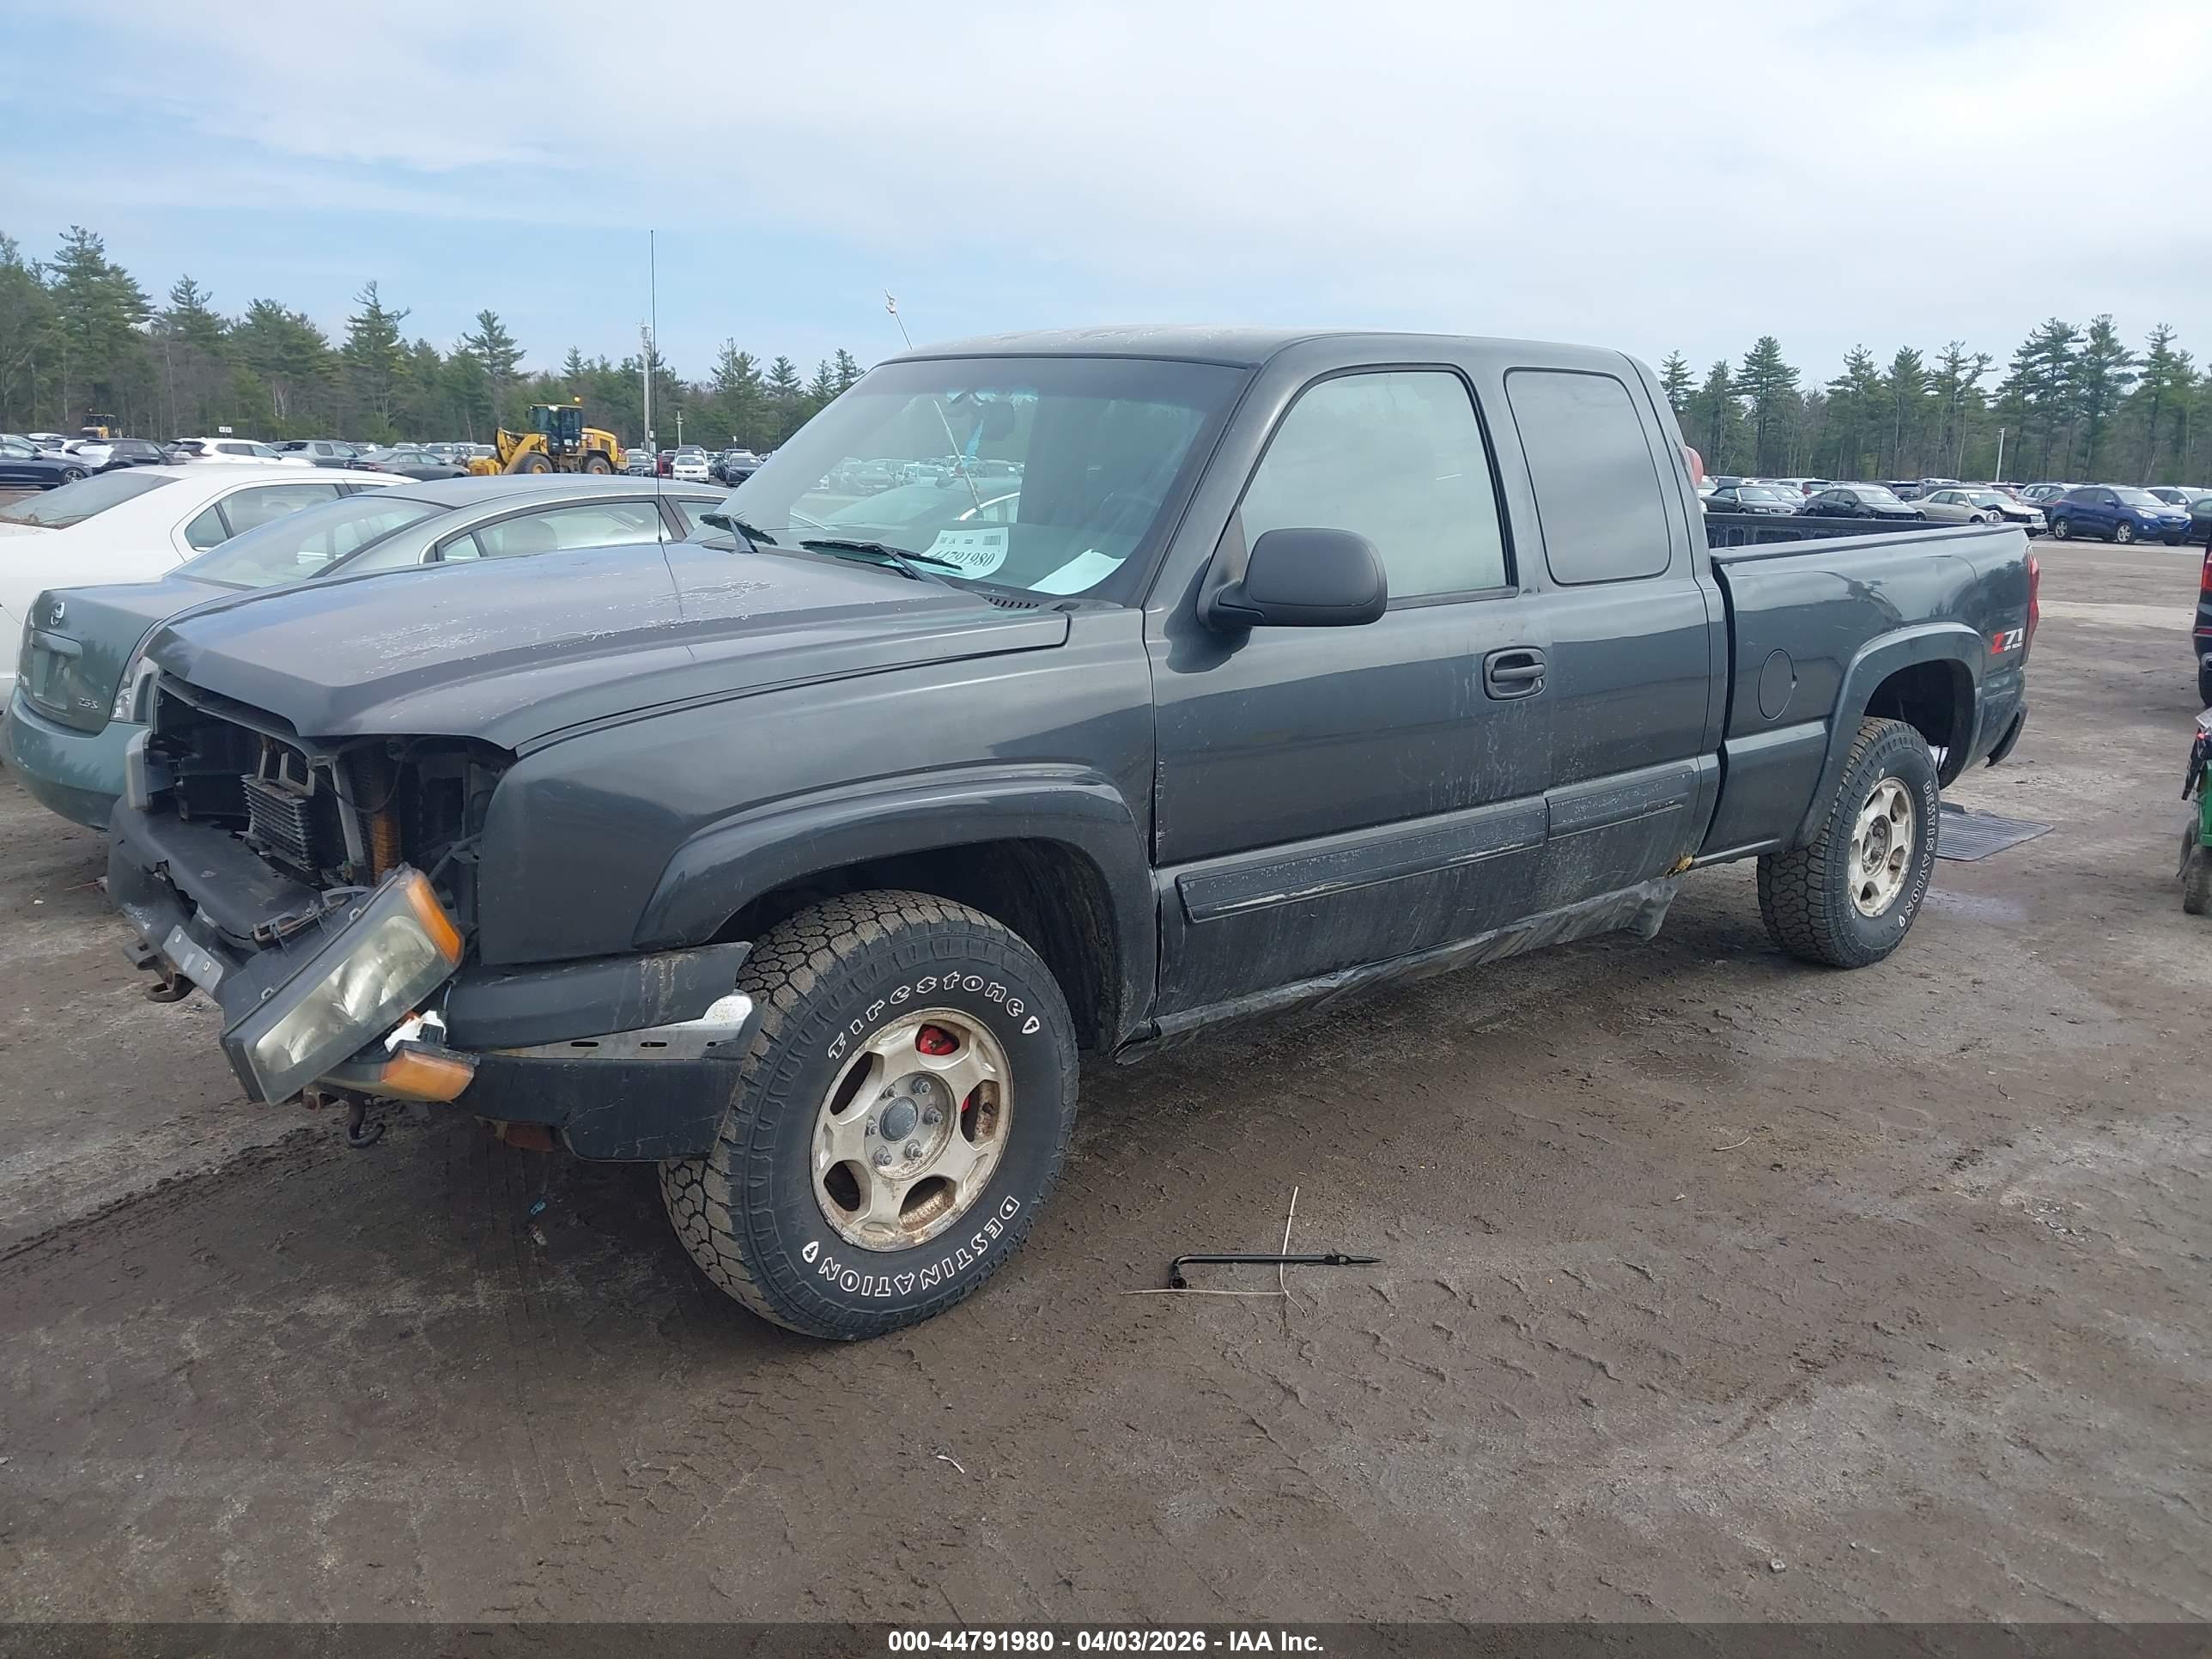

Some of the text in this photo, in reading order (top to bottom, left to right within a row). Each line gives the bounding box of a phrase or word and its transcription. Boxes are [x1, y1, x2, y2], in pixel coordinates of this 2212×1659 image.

[1990, 627, 2024, 653] Z71
[1905, 780, 1936, 916] DESTINATION
[818, 1195, 1020, 1297] DESTINATION
